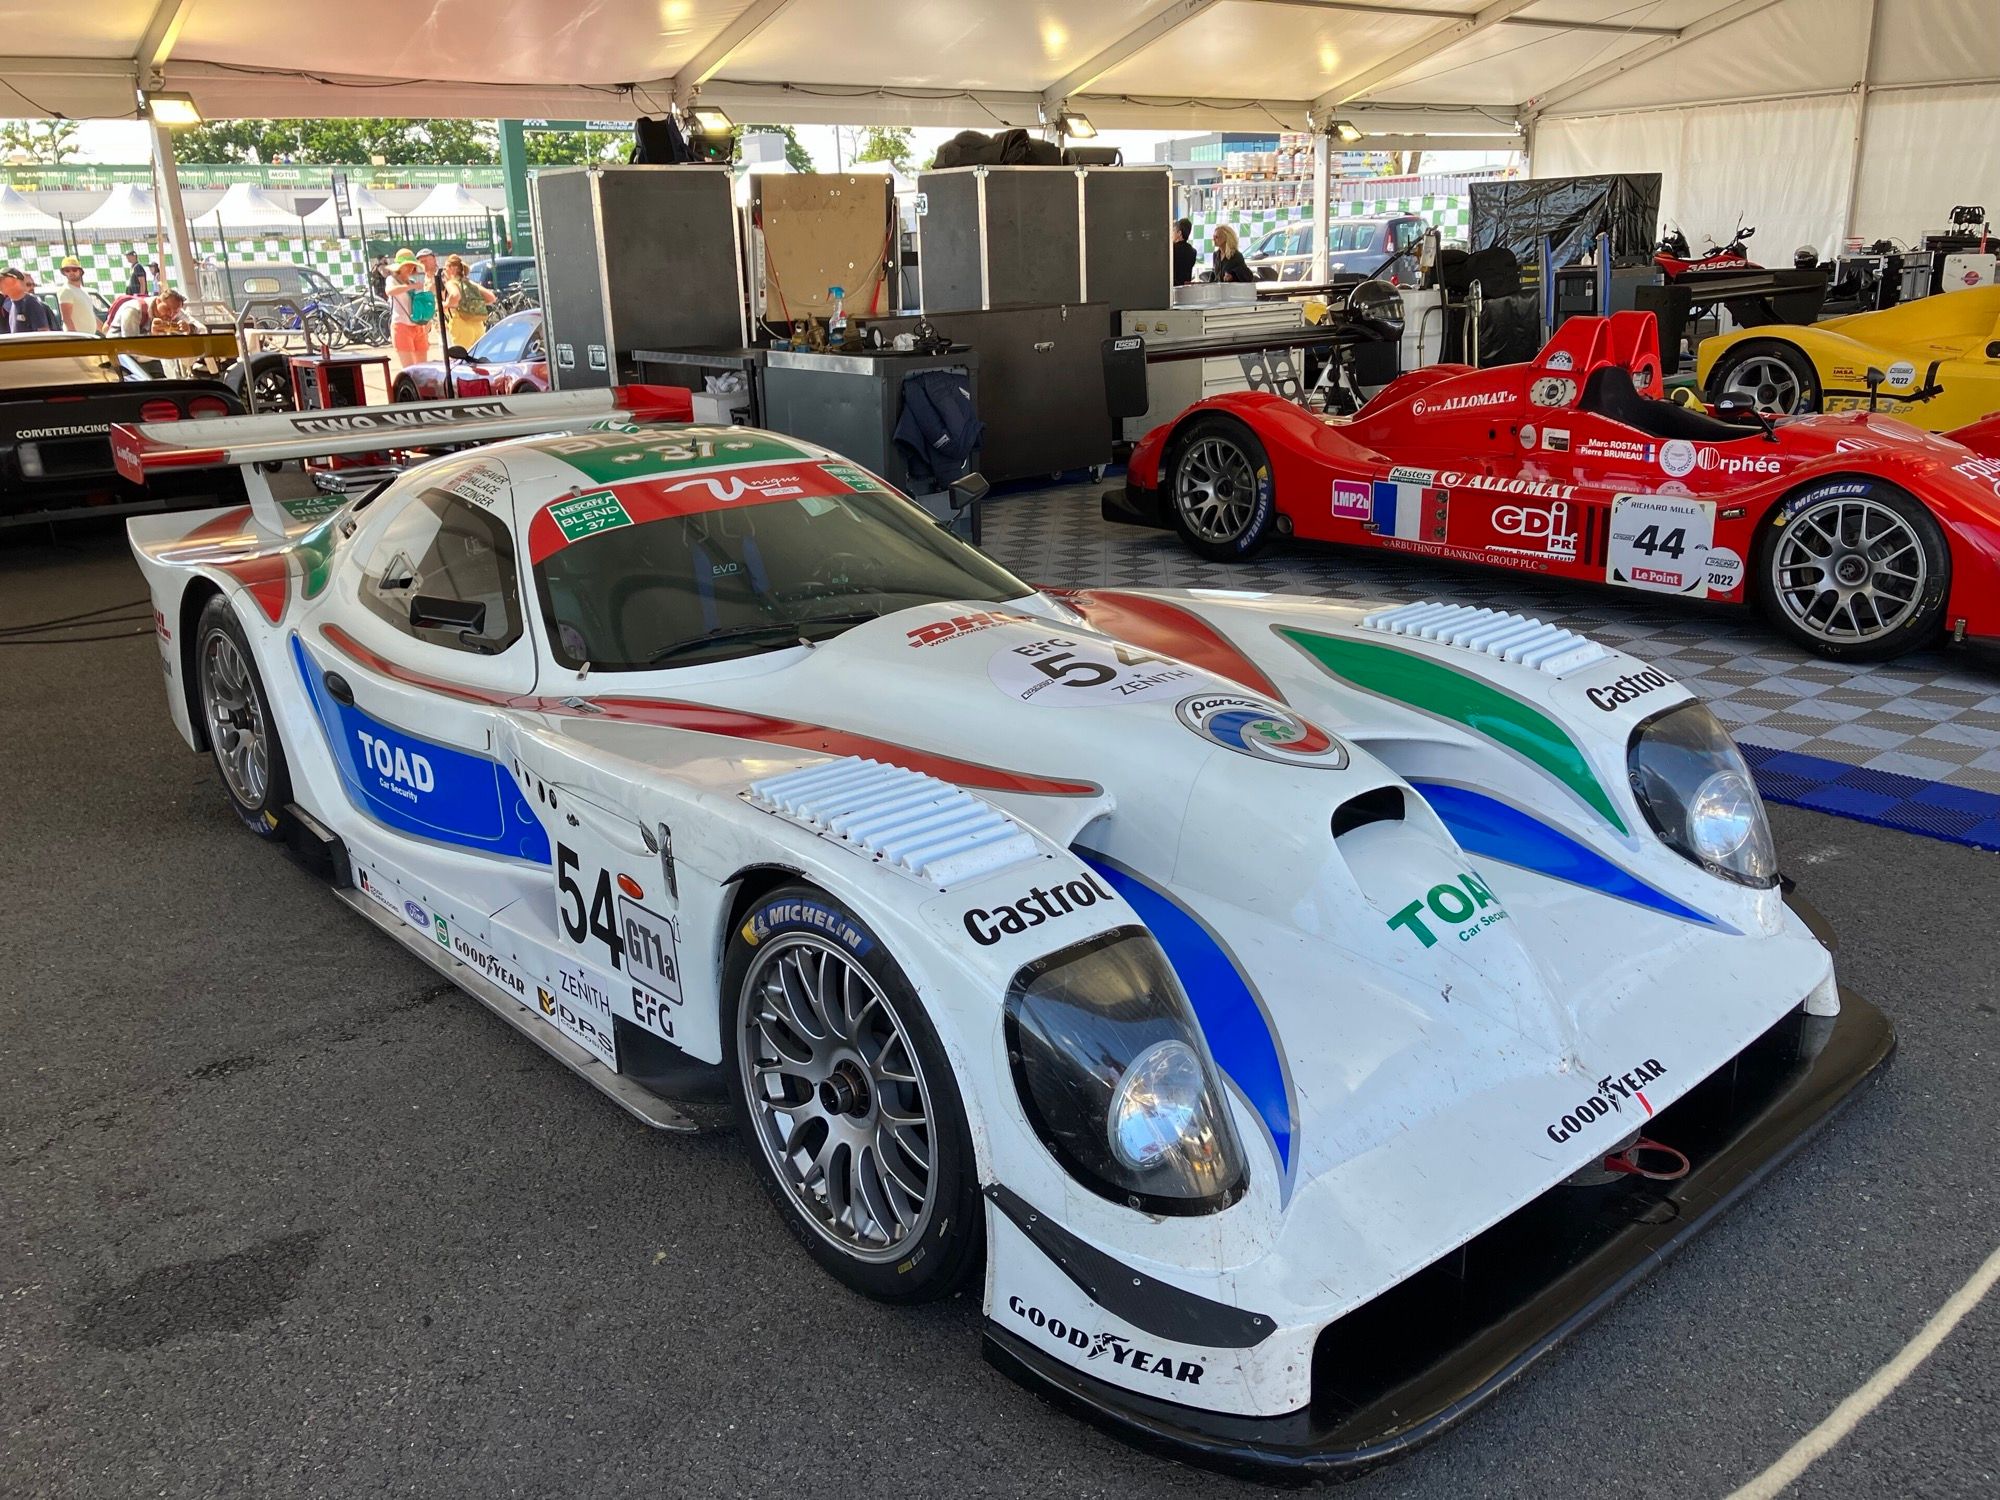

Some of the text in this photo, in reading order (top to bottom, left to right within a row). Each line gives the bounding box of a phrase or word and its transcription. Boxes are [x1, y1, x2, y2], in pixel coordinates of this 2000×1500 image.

[271, 170, 299, 179] MOTUL
[1891, 377, 1909, 385] 2022
[296, 404, 503, 434] TWO WAY TV
[1581, 446, 1643, 461] Pierre BRUNEAU
[1588, 438, 1643, 451] Marc ROSTAN
[479, 468, 509, 485] WEAVER
[1391, 467, 1432, 480] Masters
[1334, 490, 1369, 510] LMP2b
[1466, 474, 1578, 500] ALLOMAT
[1794, 484, 1865, 511] MICHELIN
[561, 506, 620, 528] BLEND
[1239, 490, 1270, 550] MICHELIN
[1630, 502, 1696, 515] RICHARD MILLE
[1389, 539, 1539, 570] ARBUTHNOT BANKING GROUP PLC
[1632, 524, 1687, 560] 44
[712, 562, 737, 575] EVO
[1635, 569, 1679, 585] Le Point
[1707, 572, 1733, 586] 2022
[928, 623, 991, 647] WORLDWIDE
[1013, 638, 1076, 657] EFG
[1111, 668, 1193, 697] ZENITH
[1586, 666, 1674, 712] Castrol
[357, 730, 435, 794] TOAD
[379, 777, 418, 803] Car Security
[557, 840, 625, 972] 54
[963, 872, 1114, 946] Castrol
[1386, 871, 1502, 949] TOA
[769, 904, 862, 949] MICHELIN
[1459, 923, 1481, 942] Car
[625, 917, 675, 983] GT1a
[559, 970, 612, 1017] ZENITH
[632, 986, 674, 1038] EFG
[559, 1004, 613, 1053] DPS
